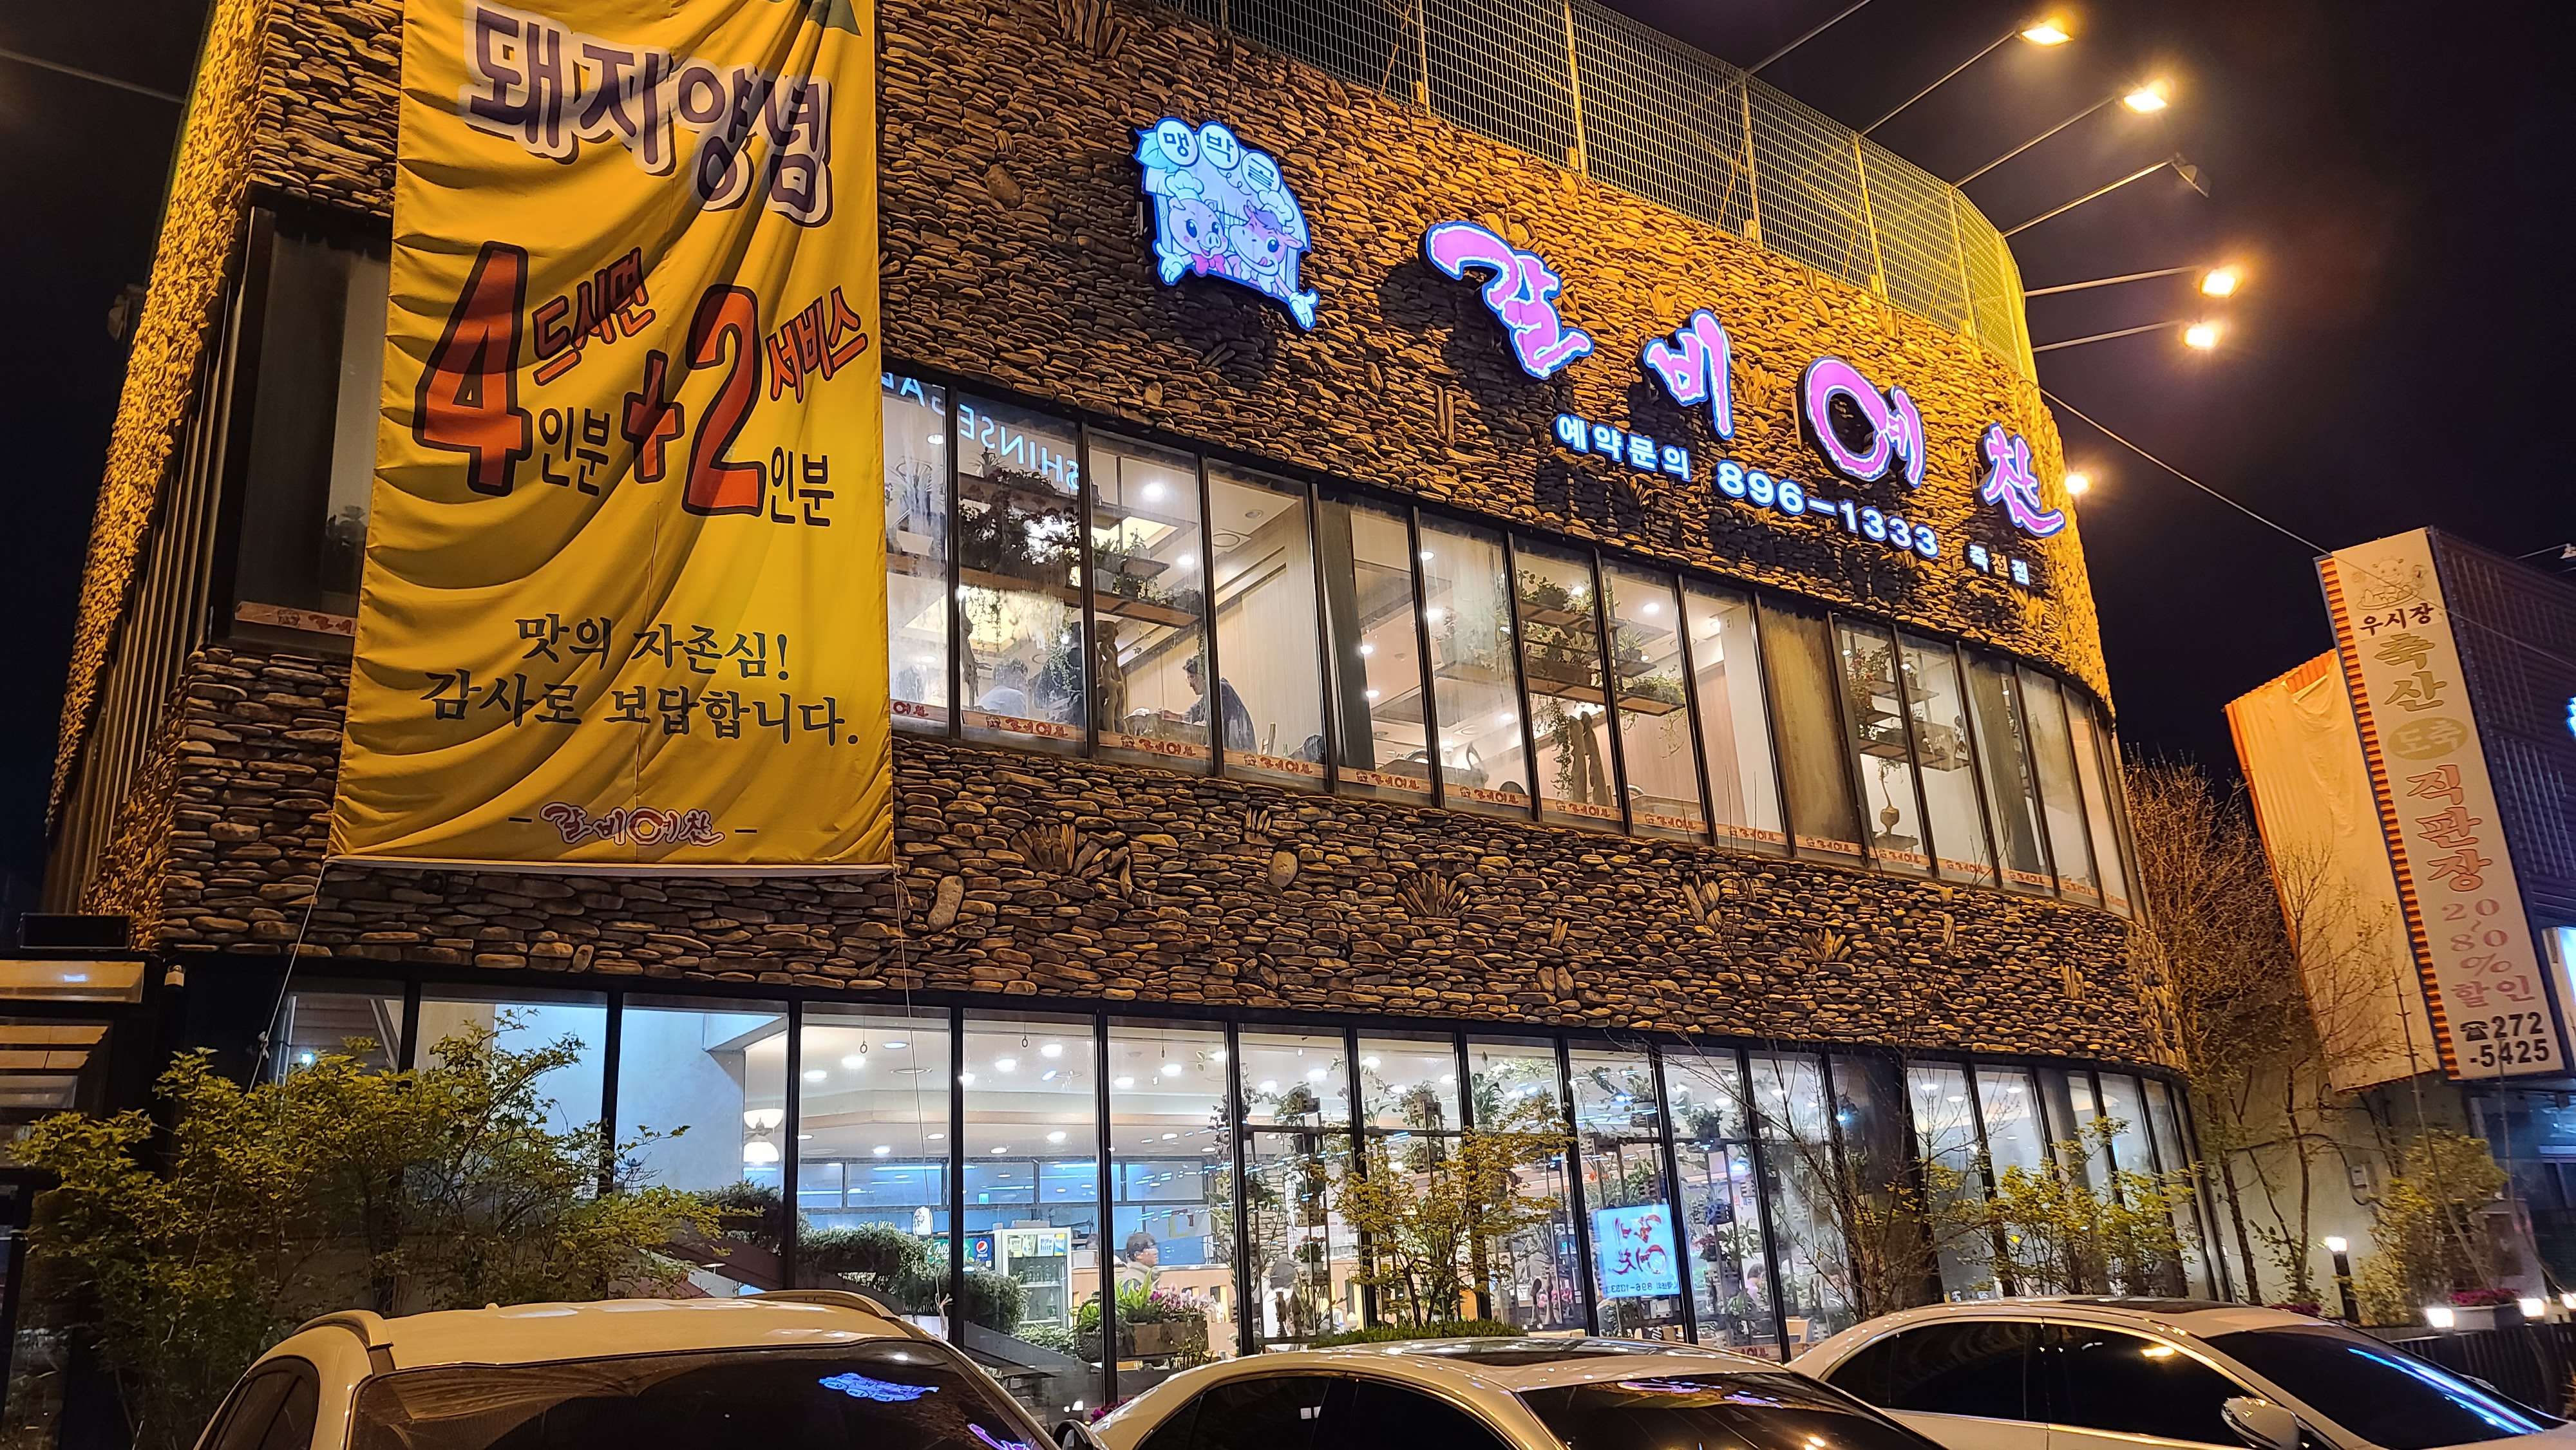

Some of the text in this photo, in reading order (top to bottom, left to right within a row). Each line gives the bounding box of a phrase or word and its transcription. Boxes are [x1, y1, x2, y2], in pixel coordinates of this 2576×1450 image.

[458, 5, 833, 227] 돼지양념
[1163, 132, 1274, 187] 맹박골
[533, 247, 656, 386] 드시면
[765, 285, 868, 403] 서비스
[538, 406, 611, 496] 인분
[770, 446, 835, 527] 인분
[1556, 413, 1939, 558] 예약문의 896-1333
[1969, 544, 2030, 586] 죽전점
[514, 612, 790, 681] 맛의 자존심!
[2359, 603, 2434, 636] 우시장
[419, 669, 859, 746] 감사로 보답합니다.
[2374, 633, 2447, 711] 축산
[2396, 720, 2461, 755] 도축
[2406, 764, 2492, 892] 직판장
[2450, 975, 2535, 1008] 할인
[2490, 1012, 2544, 1039] 272
